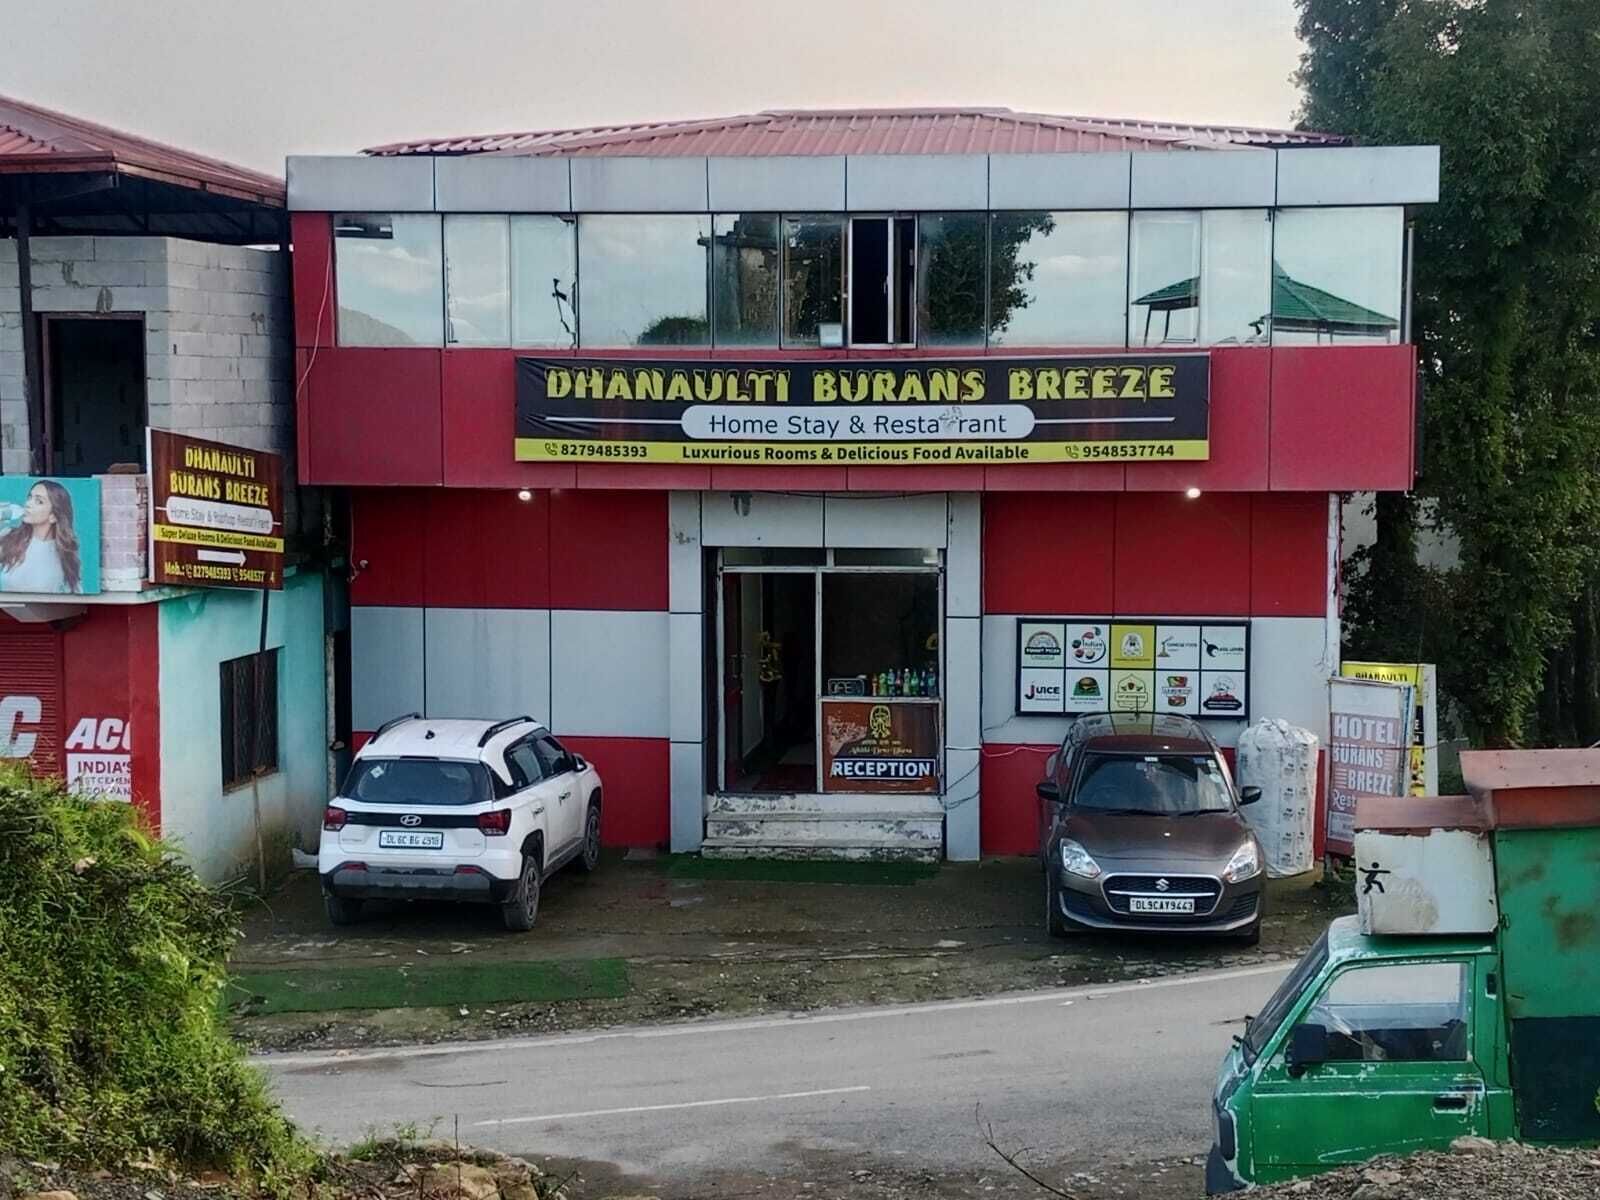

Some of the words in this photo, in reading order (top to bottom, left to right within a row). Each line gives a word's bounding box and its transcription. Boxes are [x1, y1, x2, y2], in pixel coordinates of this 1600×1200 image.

[545, 367, 791, 402] DHANAULTI
[812, 369, 986, 402] BURANS
[1008, 365, 1176, 402] BREEZE
[709, 415, 778, 434] Home
[787, 415, 840, 438] Stay
[850, 415, 865, 434] &
[873, 412, 1007, 434] Restarant
[185, 446, 256, 479] DHANAULTI
[560, 444, 648, 458] 8279485393
[682, 445, 760, 459] Luxurious
[764, 447, 817, 460] Rooms
[821, 447, 833, 460] &
[837, 446, 909, 460] Delicious
[913, 446, 951, 460] Food
[955, 445, 1029, 459] Available
[1082, 444, 1175, 458] 9548537744
[170, 470, 221, 499] BURANS
[225, 479, 270, 506] BREEZE
[1333, 714, 1397, 746] HOTEL
[831, 761, 930, 777] RECEPTION
[1333, 742, 1384, 770] BURANS
[1348, 769, 1393, 796] BREEZE
